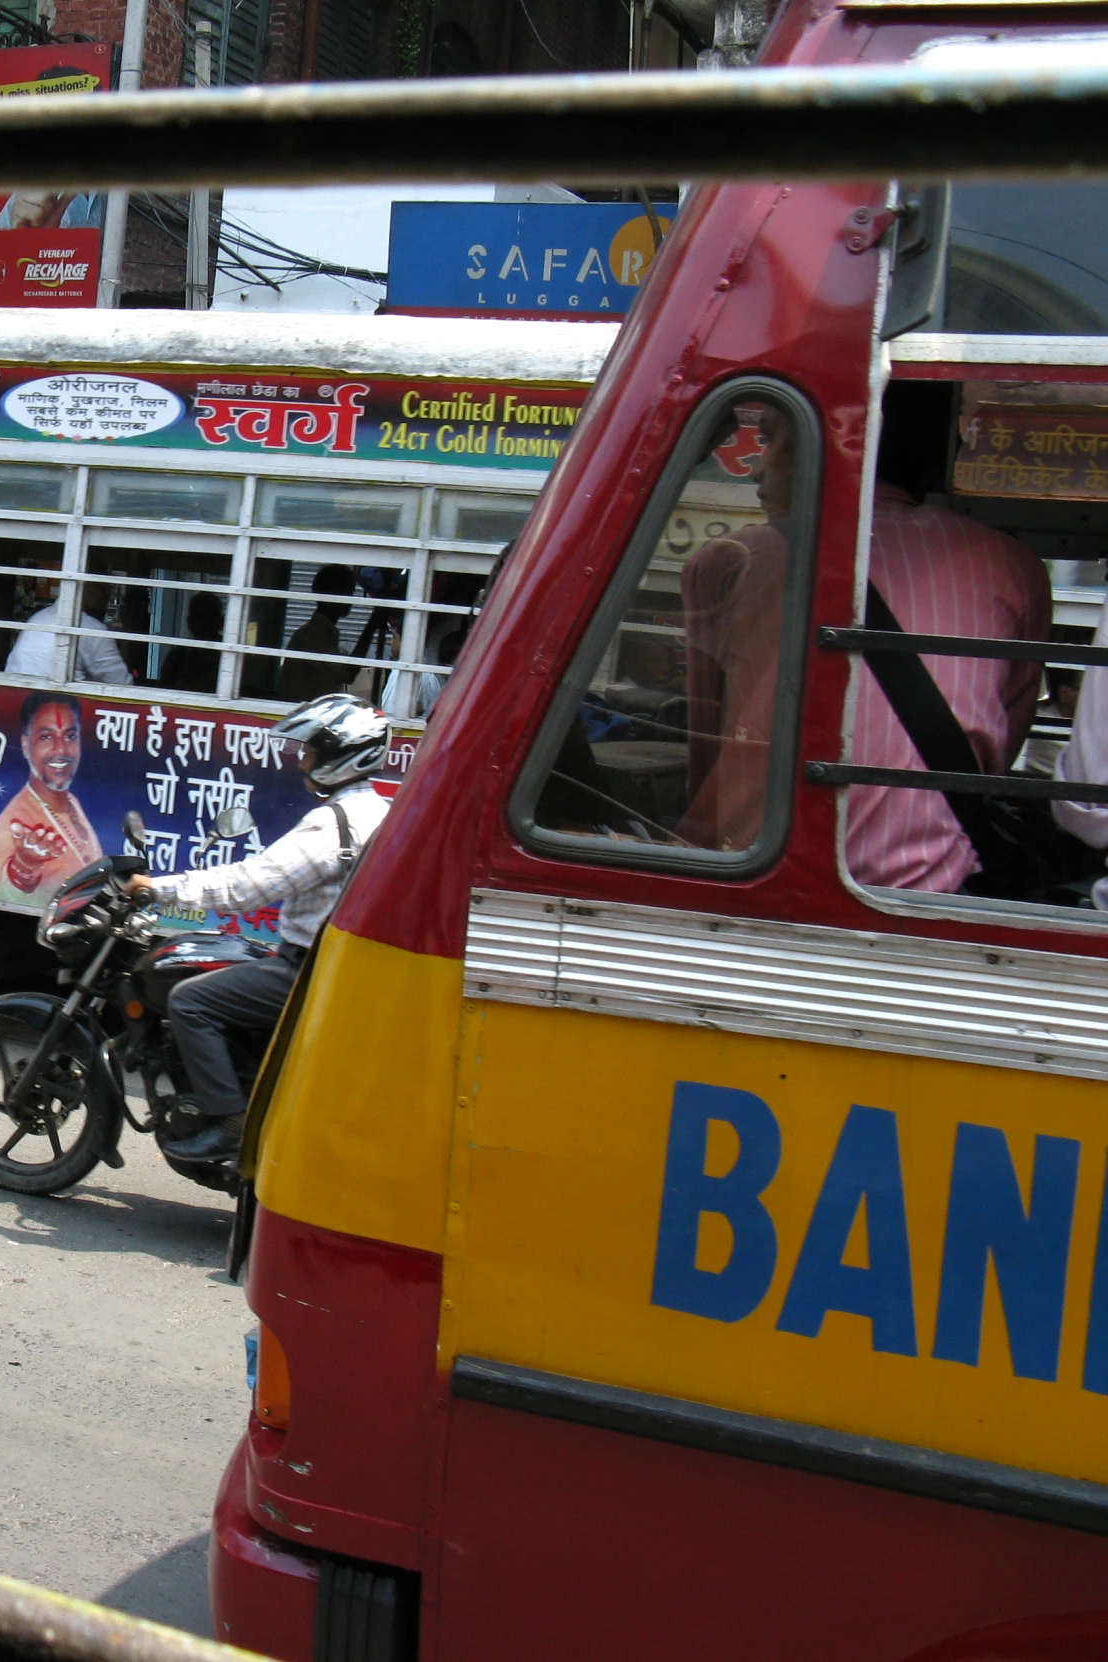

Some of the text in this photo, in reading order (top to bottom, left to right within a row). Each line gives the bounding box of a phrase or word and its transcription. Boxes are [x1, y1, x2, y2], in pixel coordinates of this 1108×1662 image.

[35, 78, 89, 95] situations?
[39, 249, 76, 258] EVEREADY
[466, 244, 644, 285] SAFAR
[24, 258, 89, 285] RECHARGE
[478, 293, 609, 308] LUGGA
[47, 376, 139, 394] ओरीजनल
[283, 386, 300, 399] का
[26, 403, 59, 416] सबसे
[138, 409, 158, 420] पर
[194, 383, 370, 453] स्वर्ग
[436, 424, 490, 455] Gold
[95, 708, 139, 752] क्या
[145, 704, 168, 758] है
[173, 717, 216, 768] इस
[145, 756, 180, 816] जो
[651, 1079, 1108, 1398] BAN
